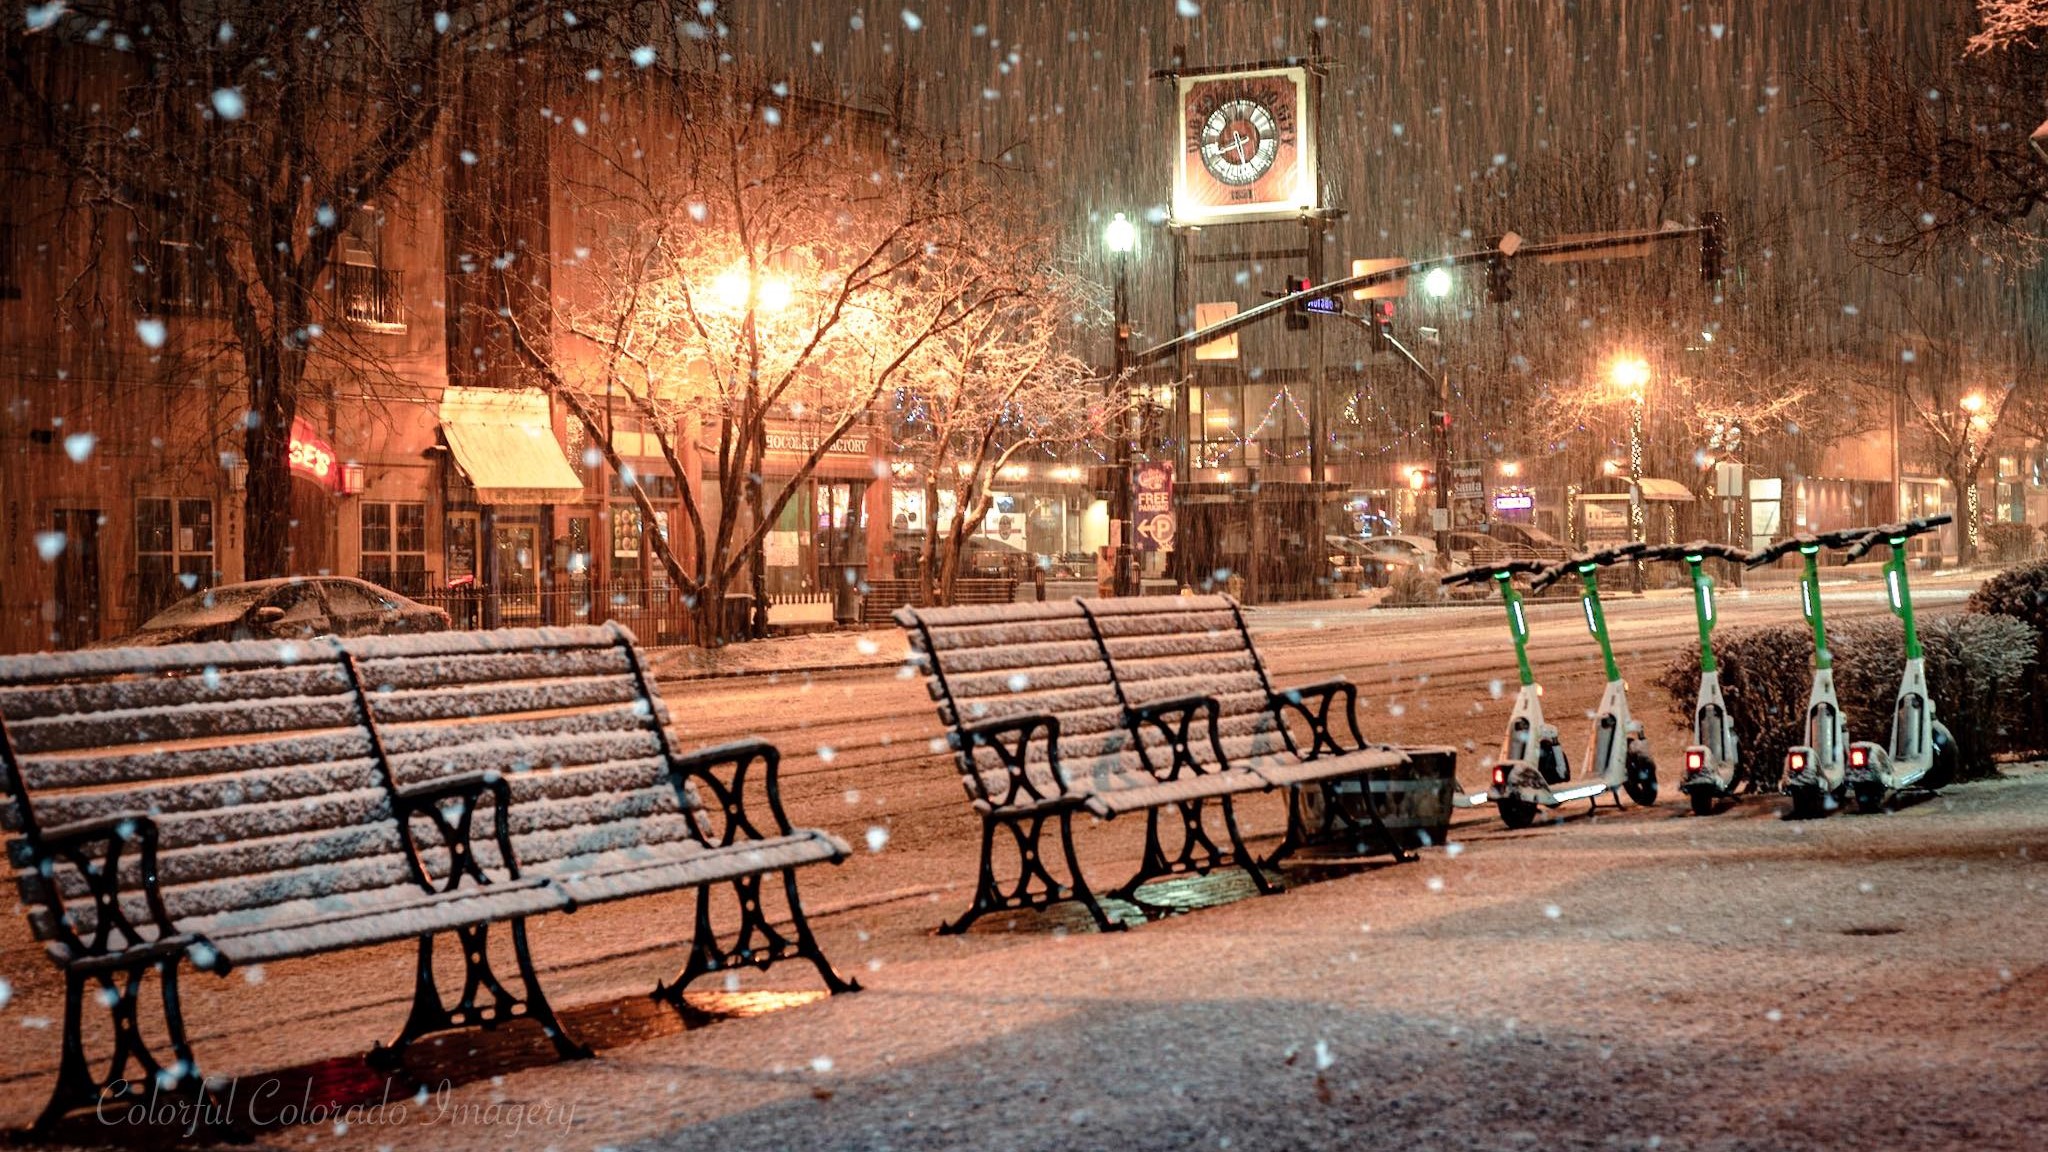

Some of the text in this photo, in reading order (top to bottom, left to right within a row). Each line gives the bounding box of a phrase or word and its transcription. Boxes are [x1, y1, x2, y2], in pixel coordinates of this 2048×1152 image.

[1454, 481, 1482, 493] Santa
[1138, 492, 1169, 504] FREE
[1156, 519, 1170, 539] P
